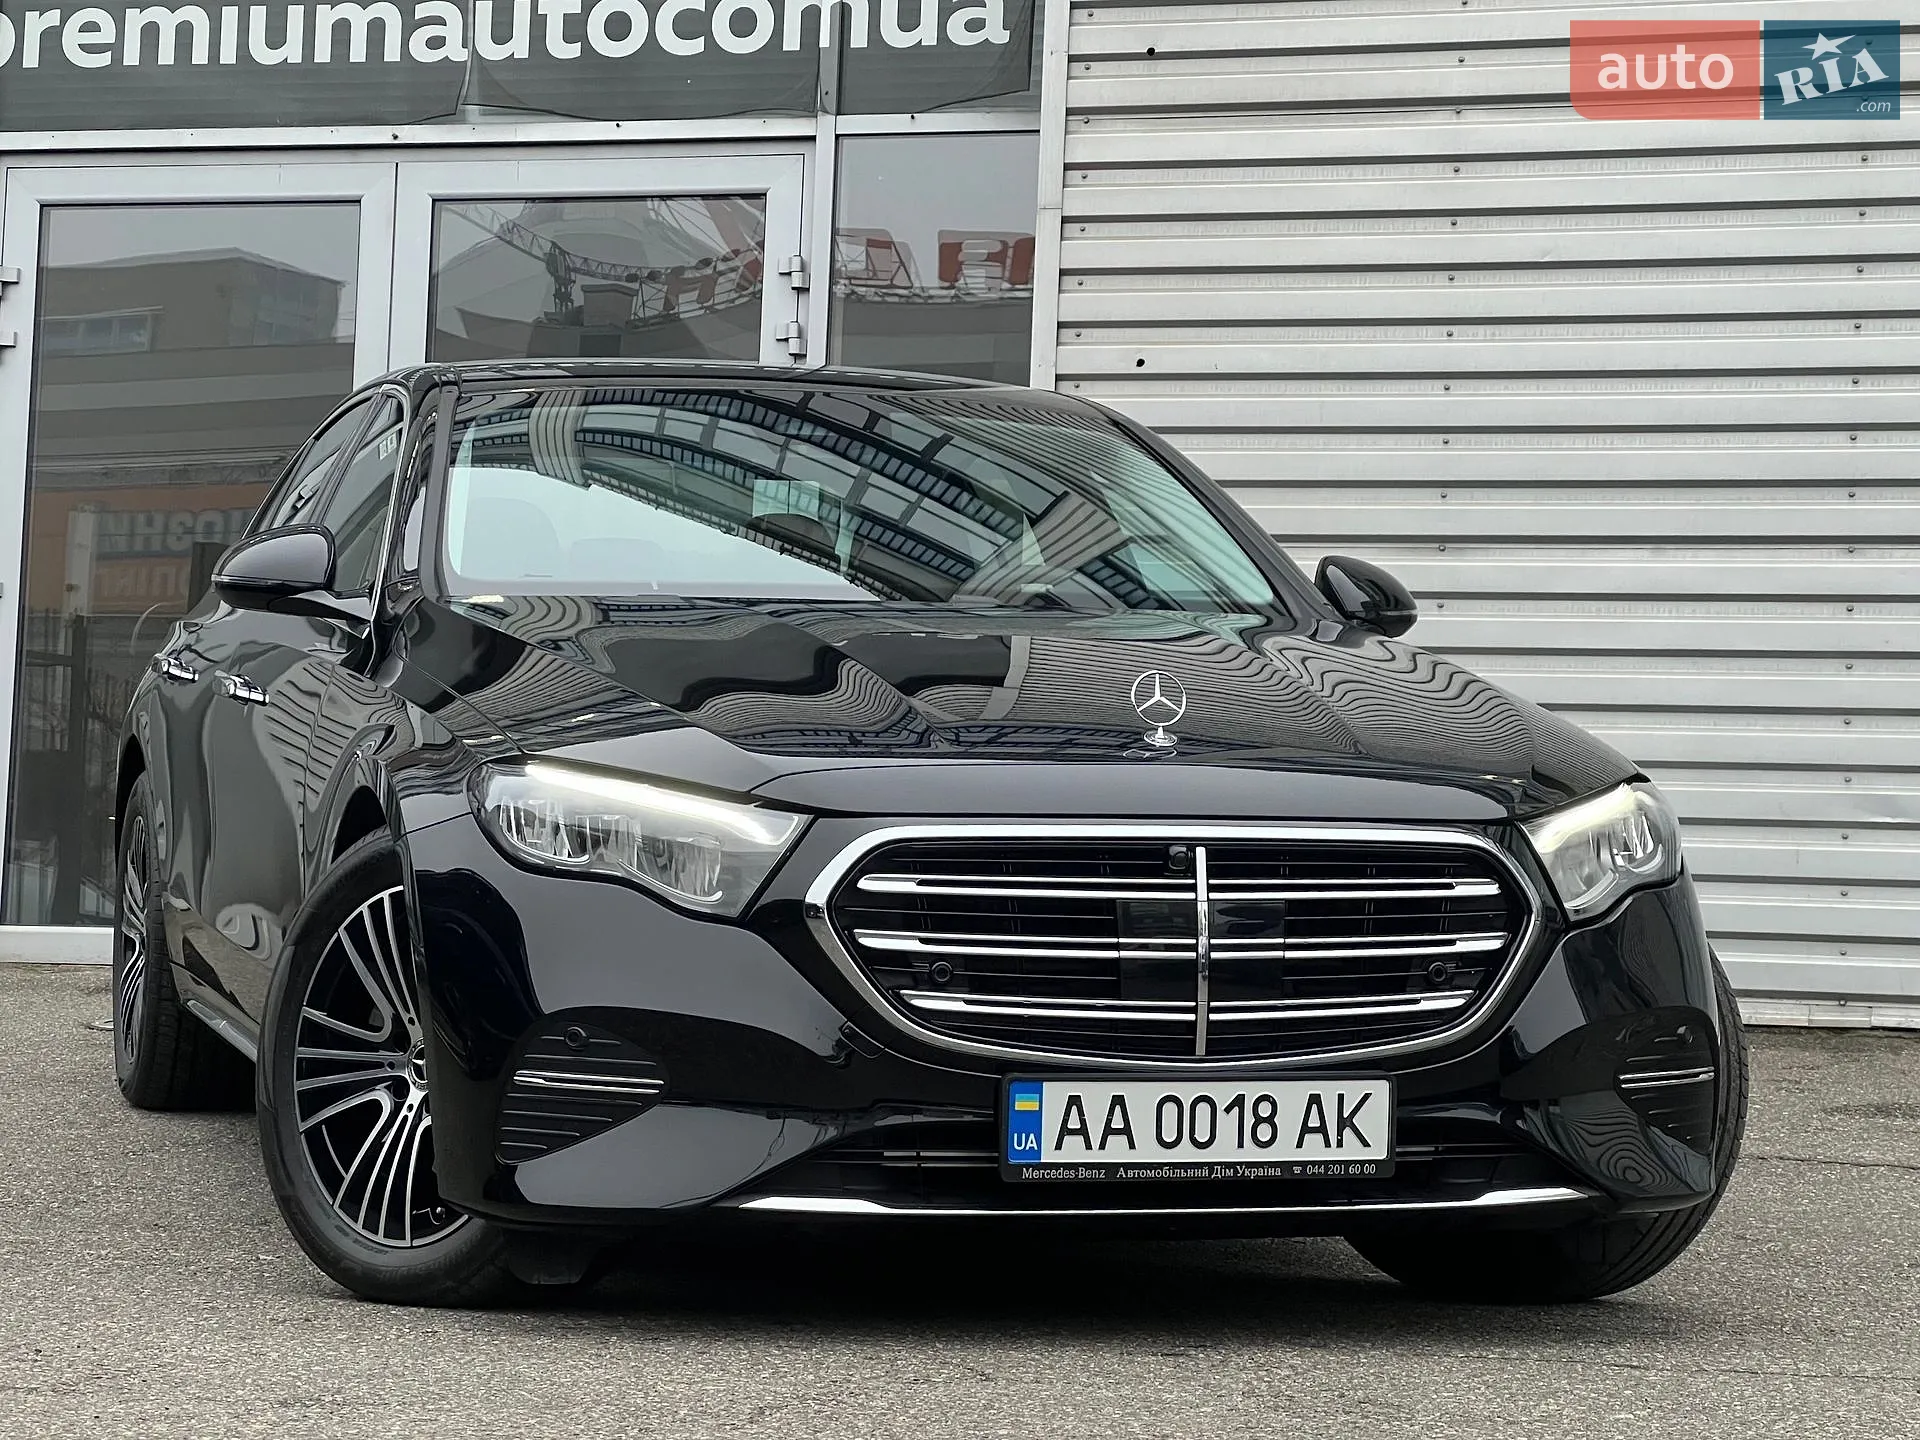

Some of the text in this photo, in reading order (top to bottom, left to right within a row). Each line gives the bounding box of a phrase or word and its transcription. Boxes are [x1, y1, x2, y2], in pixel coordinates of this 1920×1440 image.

[1054, 1092, 1373, 1151] AA 0018 AK
[1013, 1133, 1038, 1151] UA
[1022, 1167, 1106, 1179] Mercedes-Benz
[1116, 1164, 1282, 1179] Автомобільний Дім Україна
[1306, 1164, 1376, 1175] 044 201 60 00
